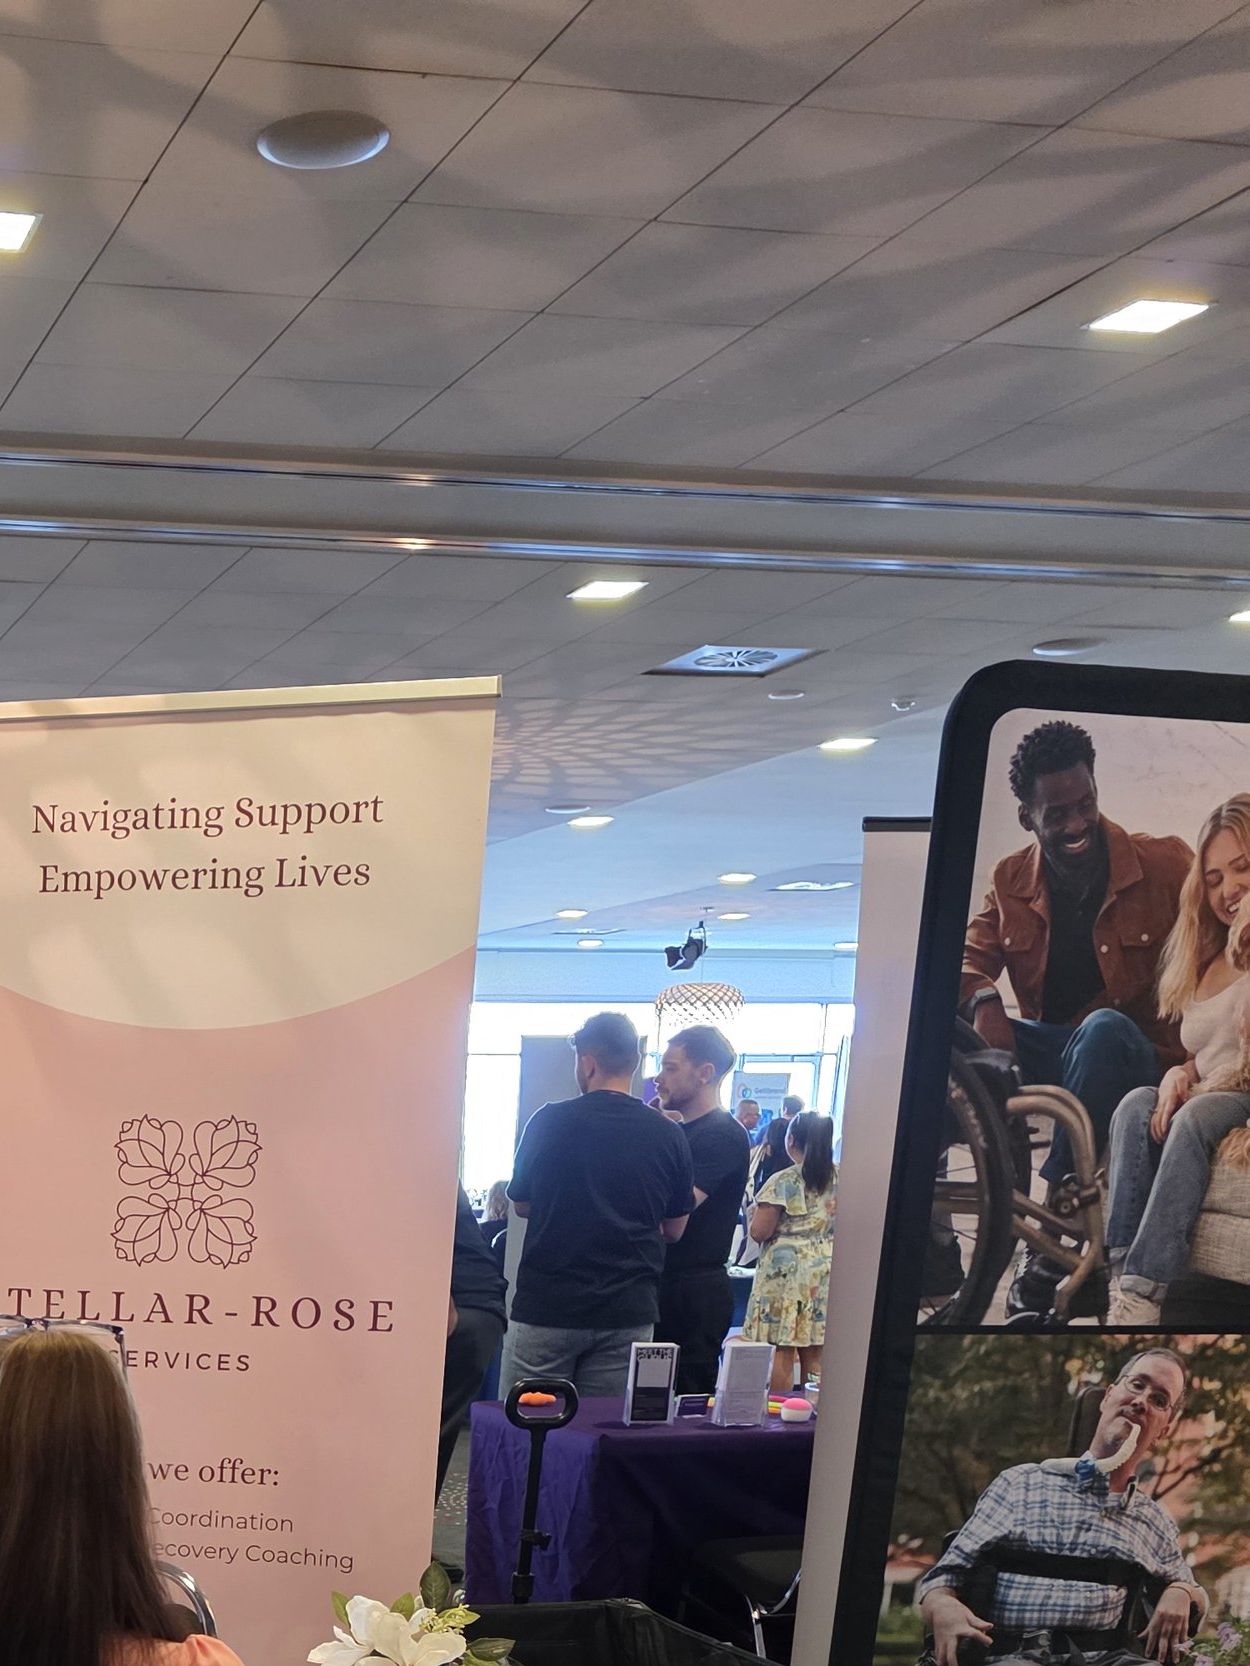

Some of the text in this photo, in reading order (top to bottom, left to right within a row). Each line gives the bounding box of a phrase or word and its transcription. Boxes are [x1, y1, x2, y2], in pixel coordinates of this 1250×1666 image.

[32, 795, 384, 840] Navigating Support
[39, 855, 371, 900] Empowering Lives
[148, 1457, 279, 1486] we offer:
[153, 1543, 353, 1574] ecovery Coaching
